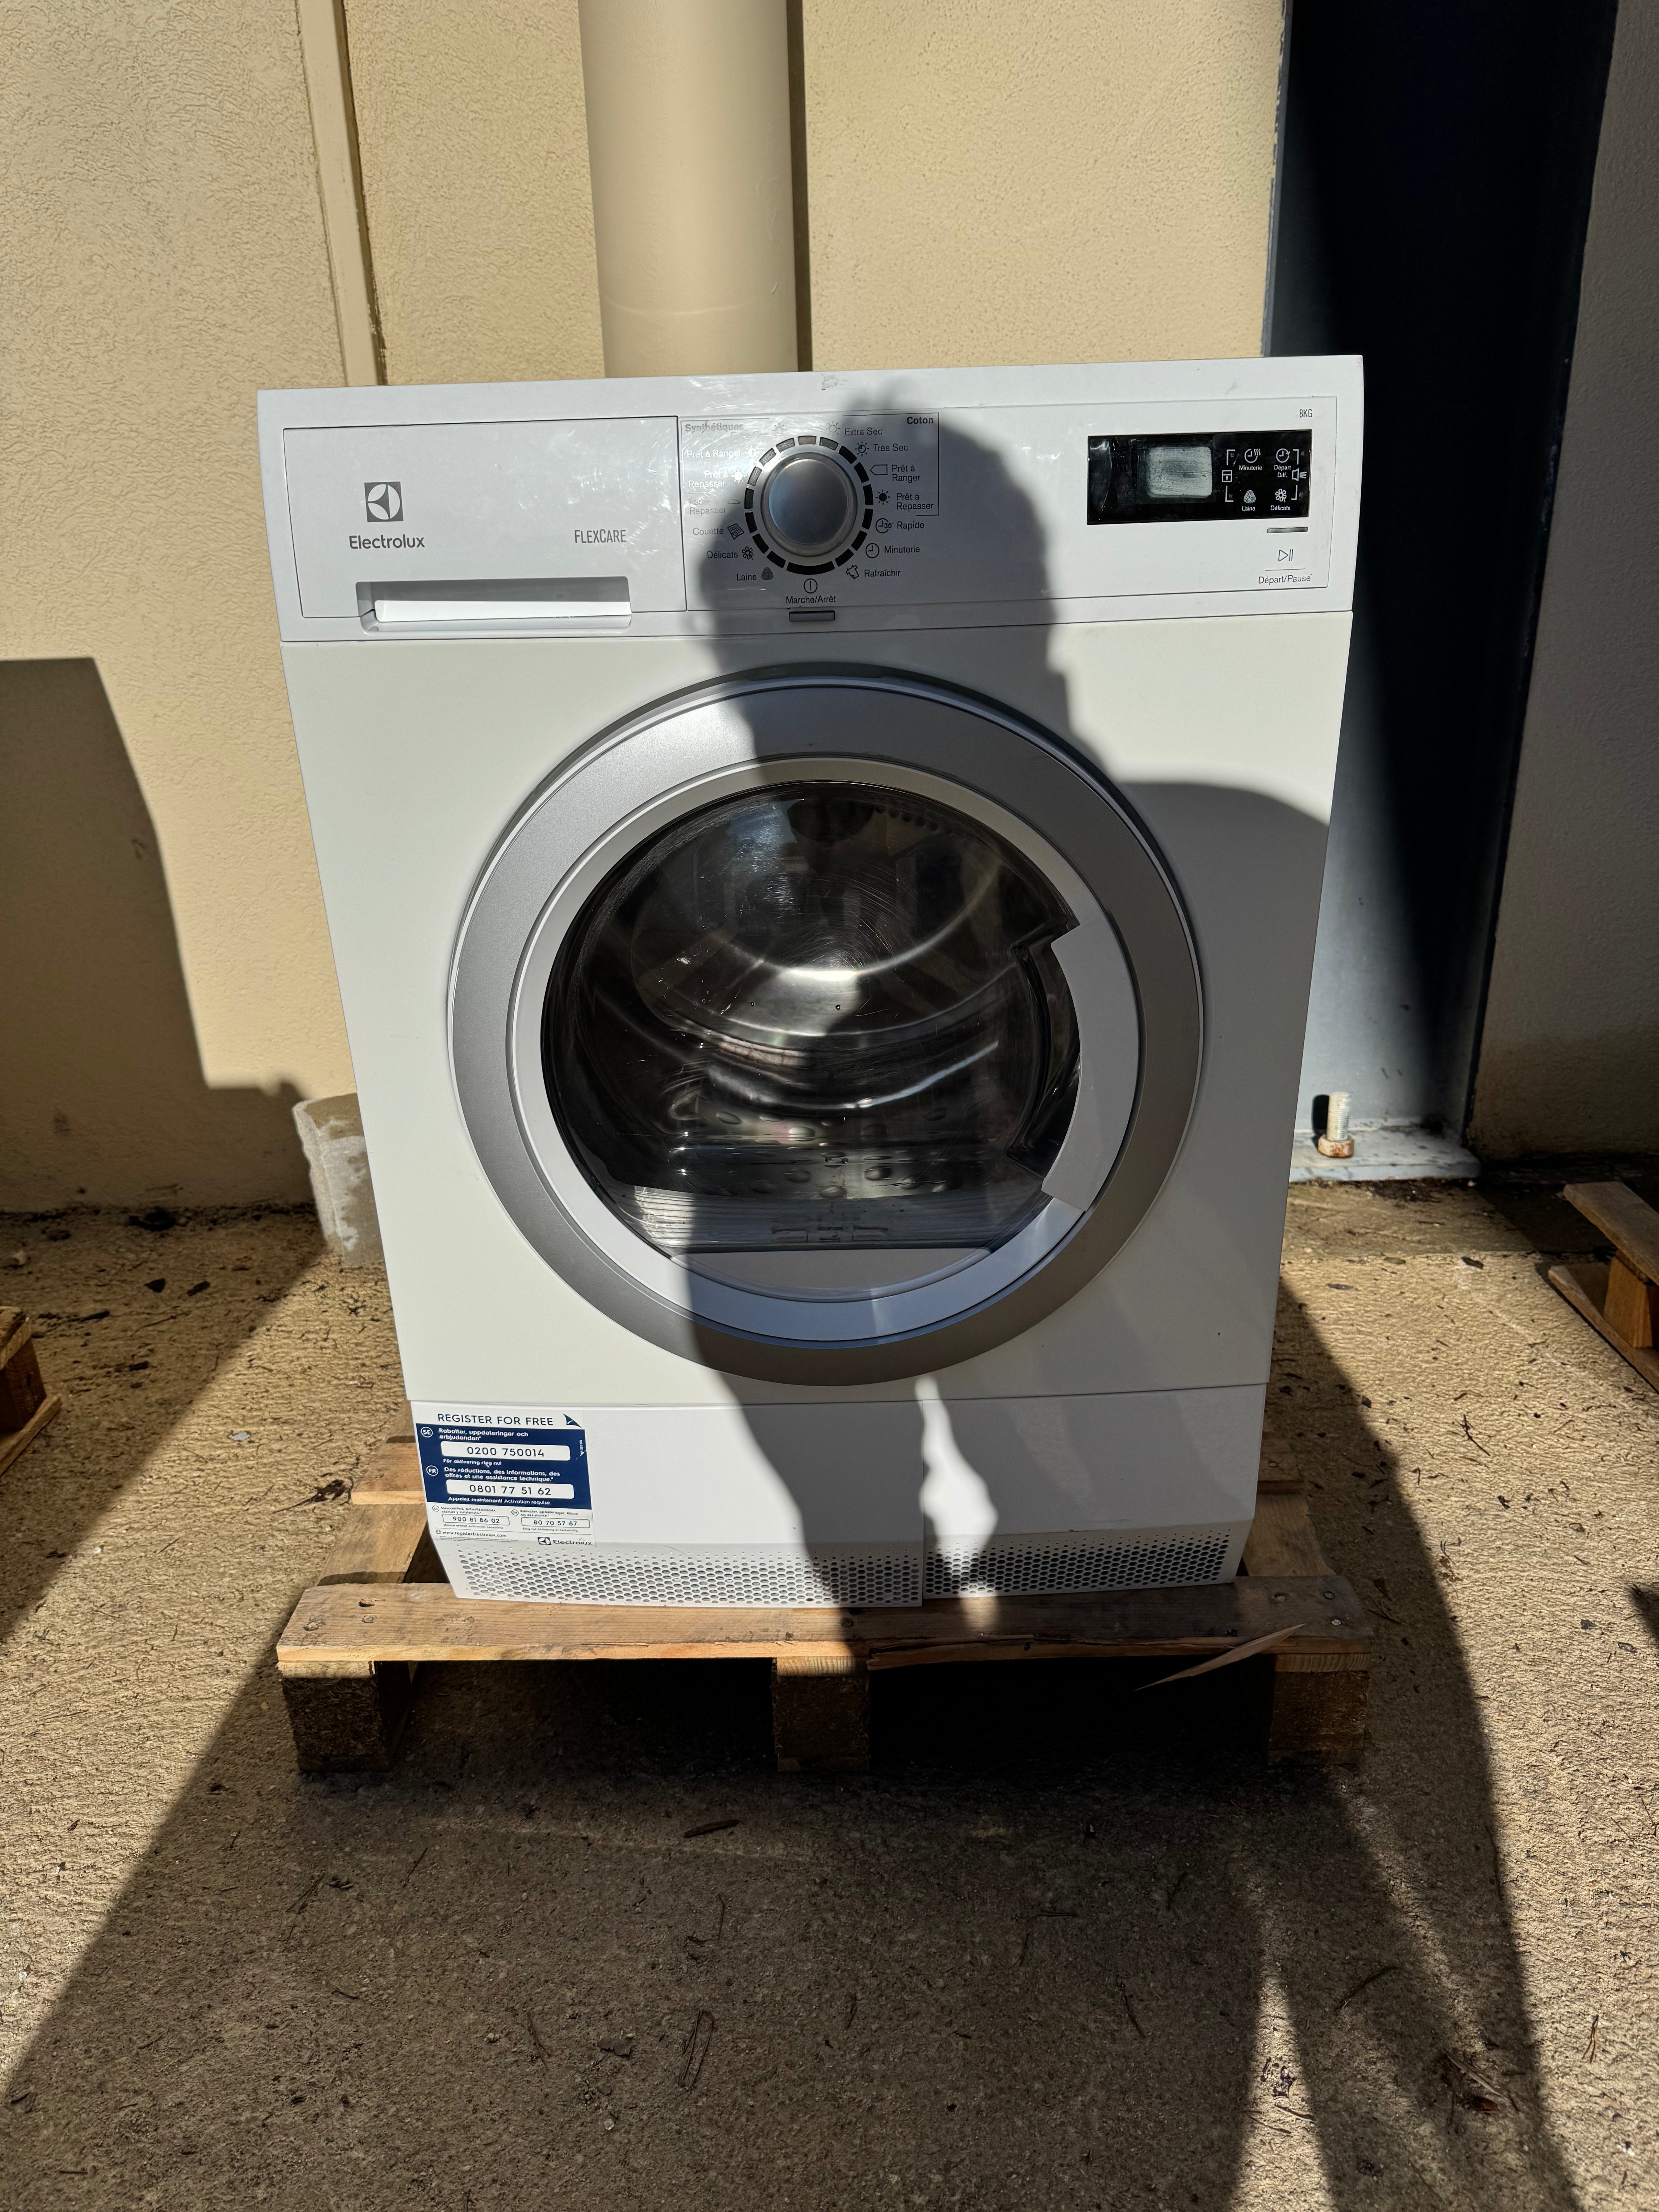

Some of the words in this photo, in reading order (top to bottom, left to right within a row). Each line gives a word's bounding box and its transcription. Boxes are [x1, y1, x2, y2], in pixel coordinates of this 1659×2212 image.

[1299, 409, 1312, 418] 8KG
[685, 422, 744, 433] Synthétiques
[845, 428, 864, 436] Extra
[713, 449, 741, 459] Ranger
[892, 474, 921, 483] Ranger
[688, 480, 725, 490] Repasser
[896, 493, 912, 501] Prêt
[896, 502, 934, 511] Repasser
[689, 507, 726, 516] Repasser
[897, 521, 924, 530] Rapide
[574, 529, 627, 543] FLEXCARE
[692, 527, 724, 536] Couette
[349, 534, 425, 549] Electrolux
[884, 545, 920, 553] Minuterie
[707, 551, 738, 559] Délicats
[864, 568, 900, 577] Rafraîchir
[1259, 575, 1311, 585] Départ/Pause
[786, 595, 836, 604] Marche/Arrêt
[438, 1413, 492, 1424] REGISTER
[497, 1416, 521, 1425] FOR
[526, 1417, 553, 1425] FREE
[467, 1446, 496, 1455] 0200
[502, 1448, 544, 1457] 750014
[470, 1485, 496, 1493] 0801
